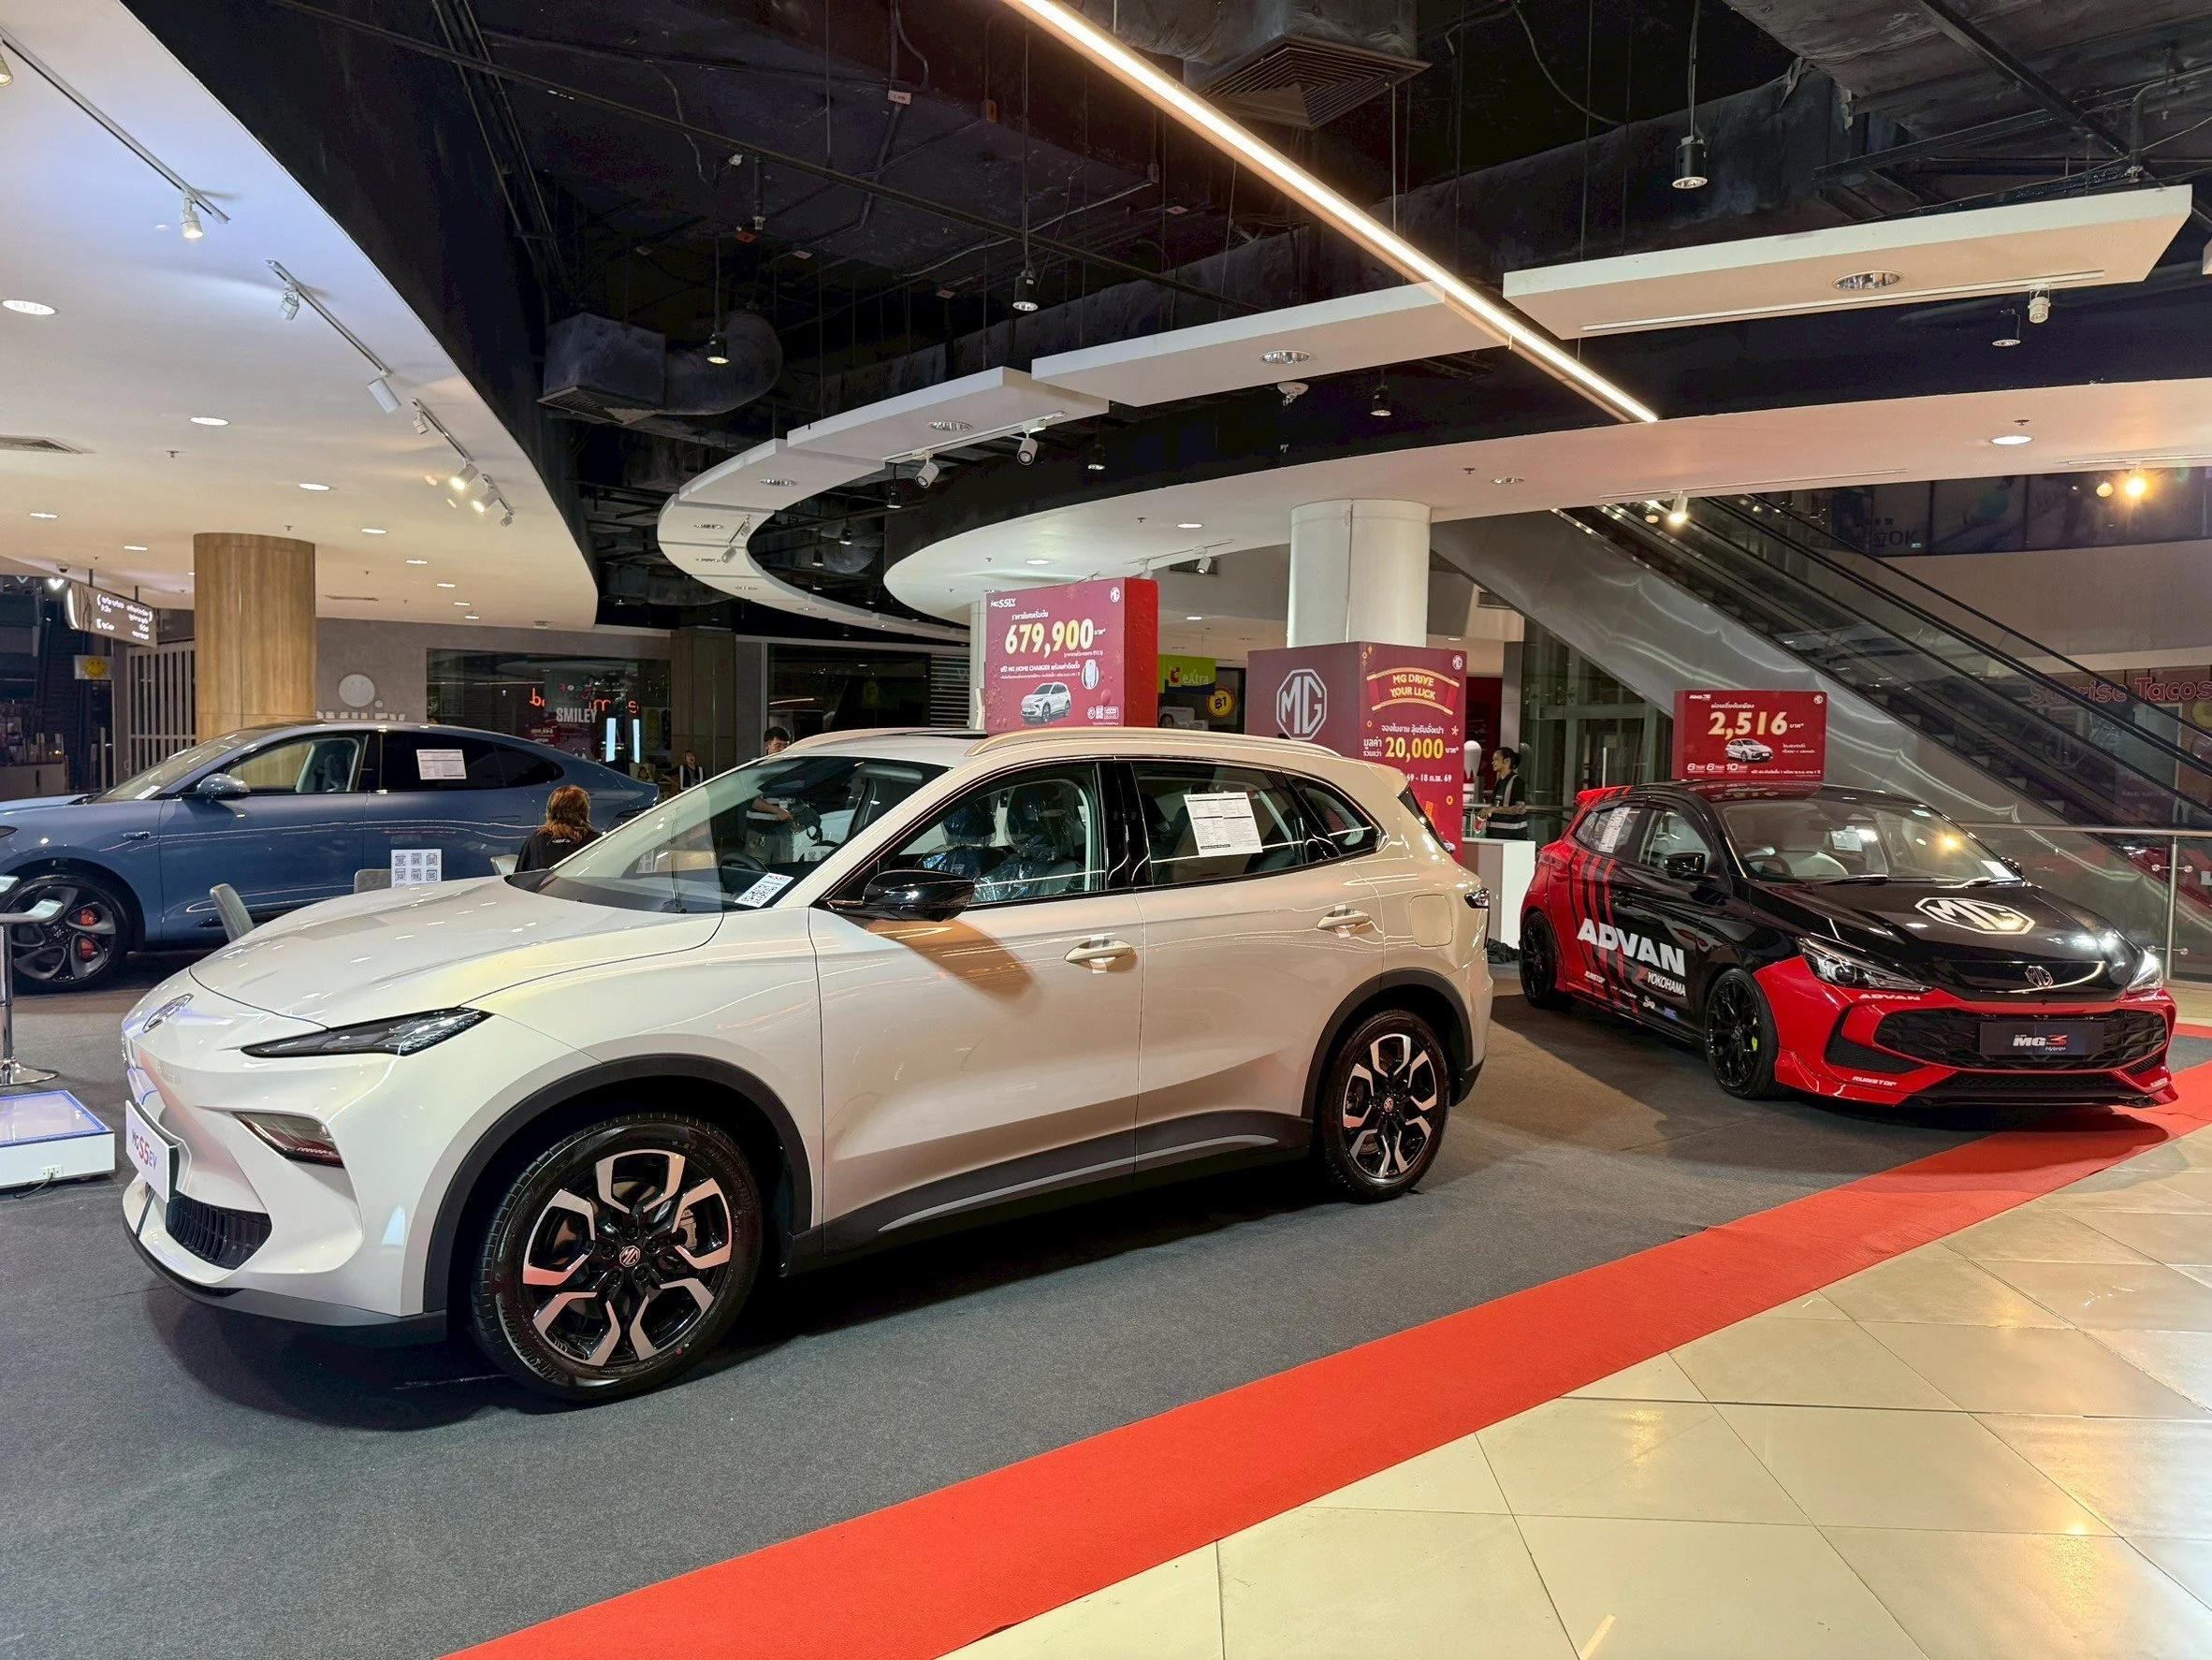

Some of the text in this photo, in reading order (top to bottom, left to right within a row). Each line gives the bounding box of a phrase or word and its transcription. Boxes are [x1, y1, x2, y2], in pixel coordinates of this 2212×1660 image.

[1005, 619, 1094, 658] 679,900
[1183, 669, 1210, 684] extra
[1392, 674, 1434, 686] MG DRIVE
[1390, 686, 1436, 700] YOUR LUCK
[2134, 677, 2212, 701] Tacos
[556, 707, 597, 723] SMILEY
[1281, 677, 1322, 735] MG
[1708, 711, 1788, 740] 2,516
[1363, 736, 1382, 750] มูลค่า
[1385, 736, 1444, 762] 20,000
[1725, 763, 1739, 771] 10
[1420, 774, 1428, 782] 18
[1444, 774, 1452, 782] 69
[1926, 899, 2024, 930] MG
[1577, 918, 1685, 977] ADVAN
[1647, 971, 1686, 997] YOKOHAMA
[2026, 967, 2052, 987] MG
[2013, 1034, 2068, 1047] MG3
[1852, 1075, 1899, 1086] RUNSTOP
[619, 1245, 641, 1267] MG
